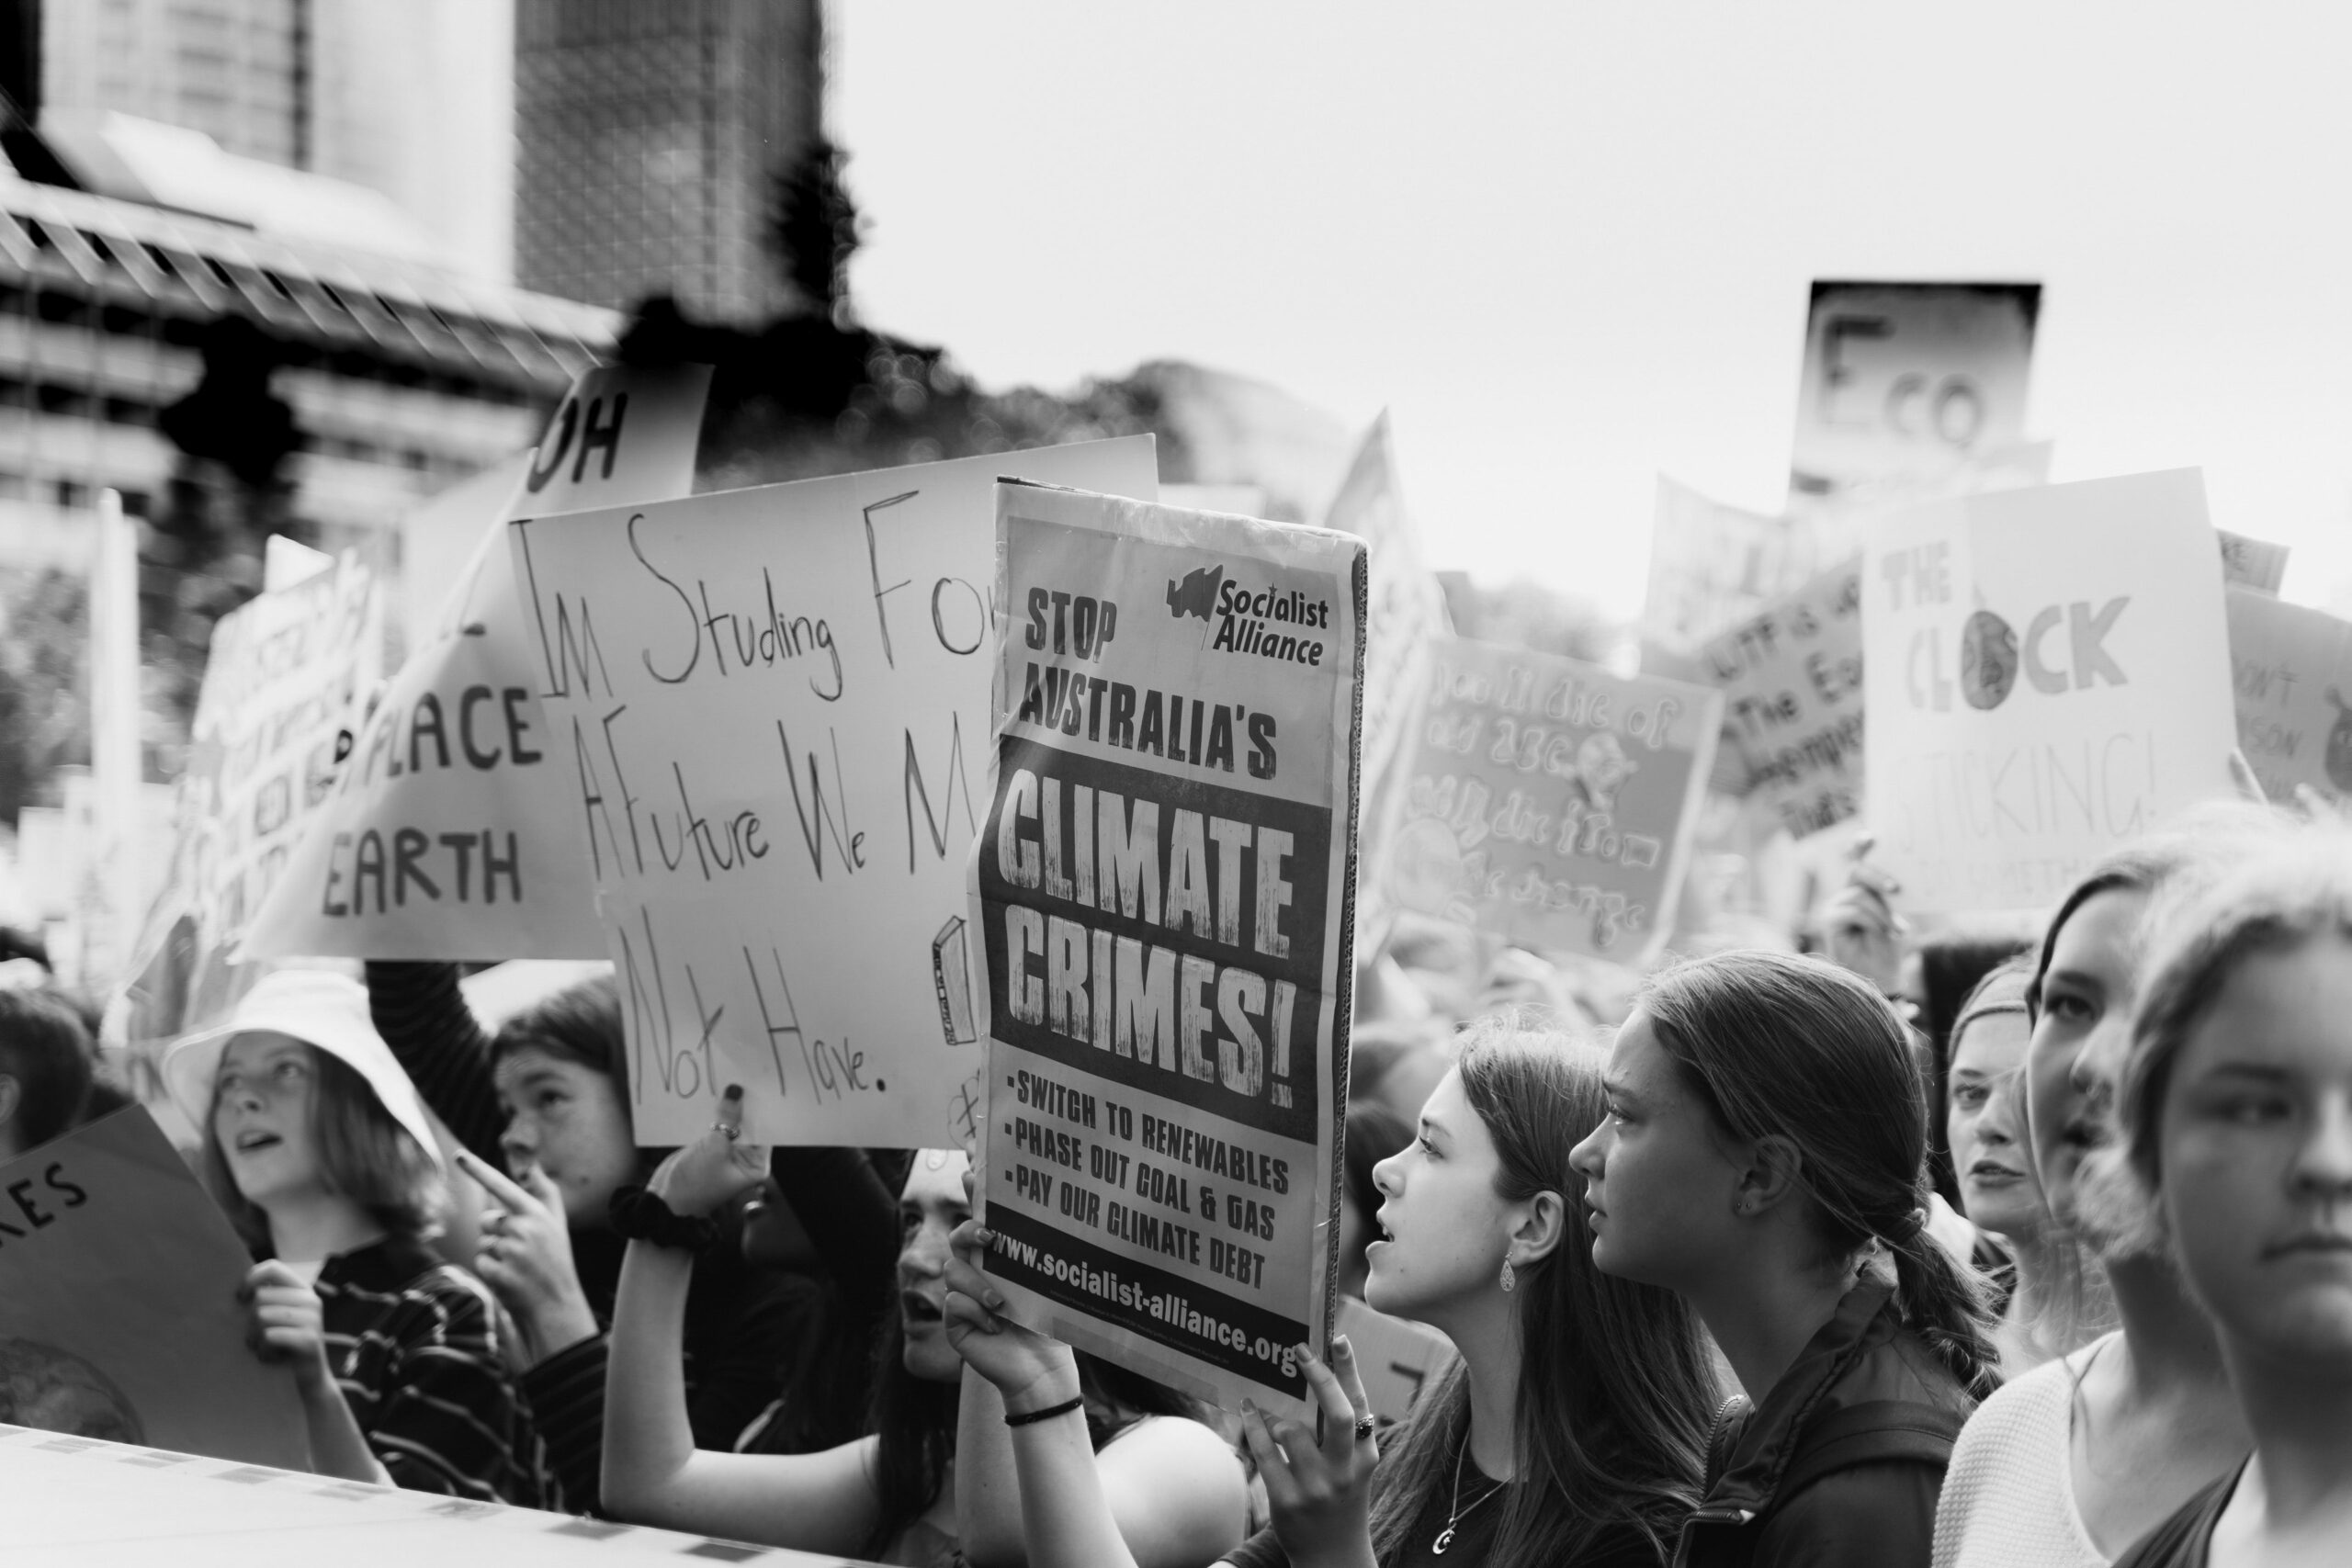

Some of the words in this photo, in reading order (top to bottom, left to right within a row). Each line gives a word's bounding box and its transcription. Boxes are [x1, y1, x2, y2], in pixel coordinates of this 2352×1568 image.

[1024, 587, 1117, 663] STOP
[1213, 614, 1324, 666] Alliance
[1216, 579, 1329, 630] Socialist
[1019, 661, 1276, 780] AUSTRALIA'S
[777, 720, 865, 882] We
[998, 769, 1295, 959] CLIMATE
[322, 826, 524, 917] EARTH
[619, 904, 724, 1106] Not
[742, 946, 887, 1105] Have.
[1005, 904, 1296, 1109] CRIMES!
[1015, 1117, 1082, 1172] PHASE
[1090, 1145, 1130, 1190] OUT
[1136, 1162, 1191, 1214] COAL
[1200, 1187, 1217, 1222] &
[1227, 1194, 1275, 1242] GAS
[1016, 1069, 1096, 1129] SWITCH
[1106, 1101, 1133, 1141] TO
[1141, 1113, 1289, 1195] RENEWABLES
[1015, 1164, 1052, 1207] PAY
[1059, 1181, 1100, 1228] OUR
[1106, 1200, 1200, 1267] CLIMATE
[1209, 1237, 1265, 1290] DEBT
[992, 1229, 1297, 1378] www.socialist-alliance.org
